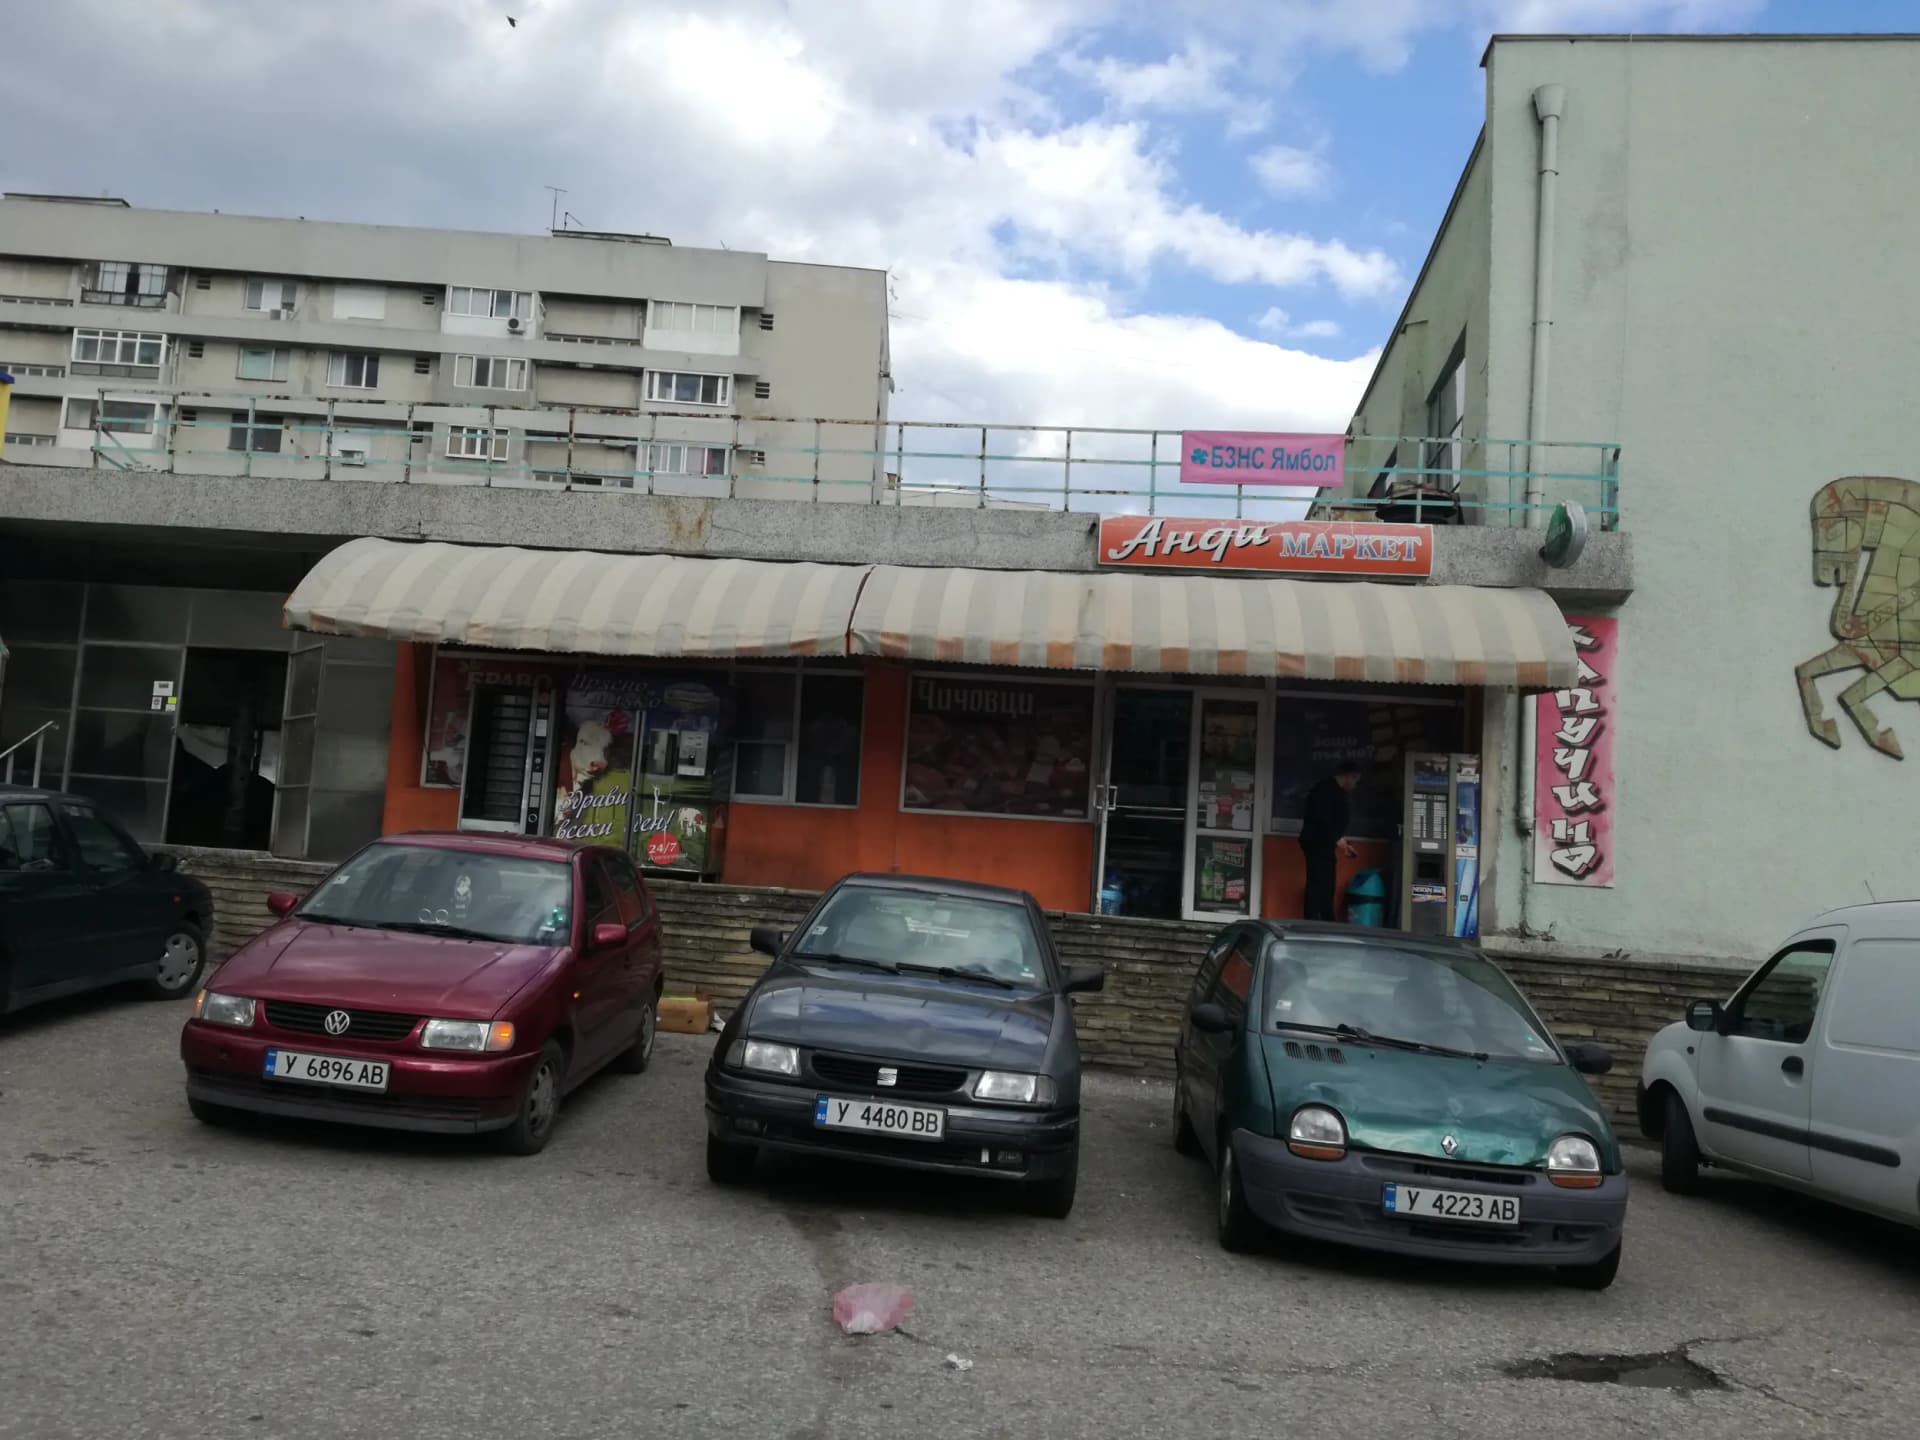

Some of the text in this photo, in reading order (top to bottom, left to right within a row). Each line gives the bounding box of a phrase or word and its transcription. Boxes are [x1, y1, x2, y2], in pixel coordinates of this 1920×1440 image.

[1211, 446, 1335, 471] БЗНС Ямбол
[1108, 517, 1422, 562] Анди МАРКЕТ
[918, 680, 1034, 719] Чичовци
[562, 785, 629, 818] Здрави
[556, 818, 613, 839] всеки
[648, 842, 677, 854] 24/7
